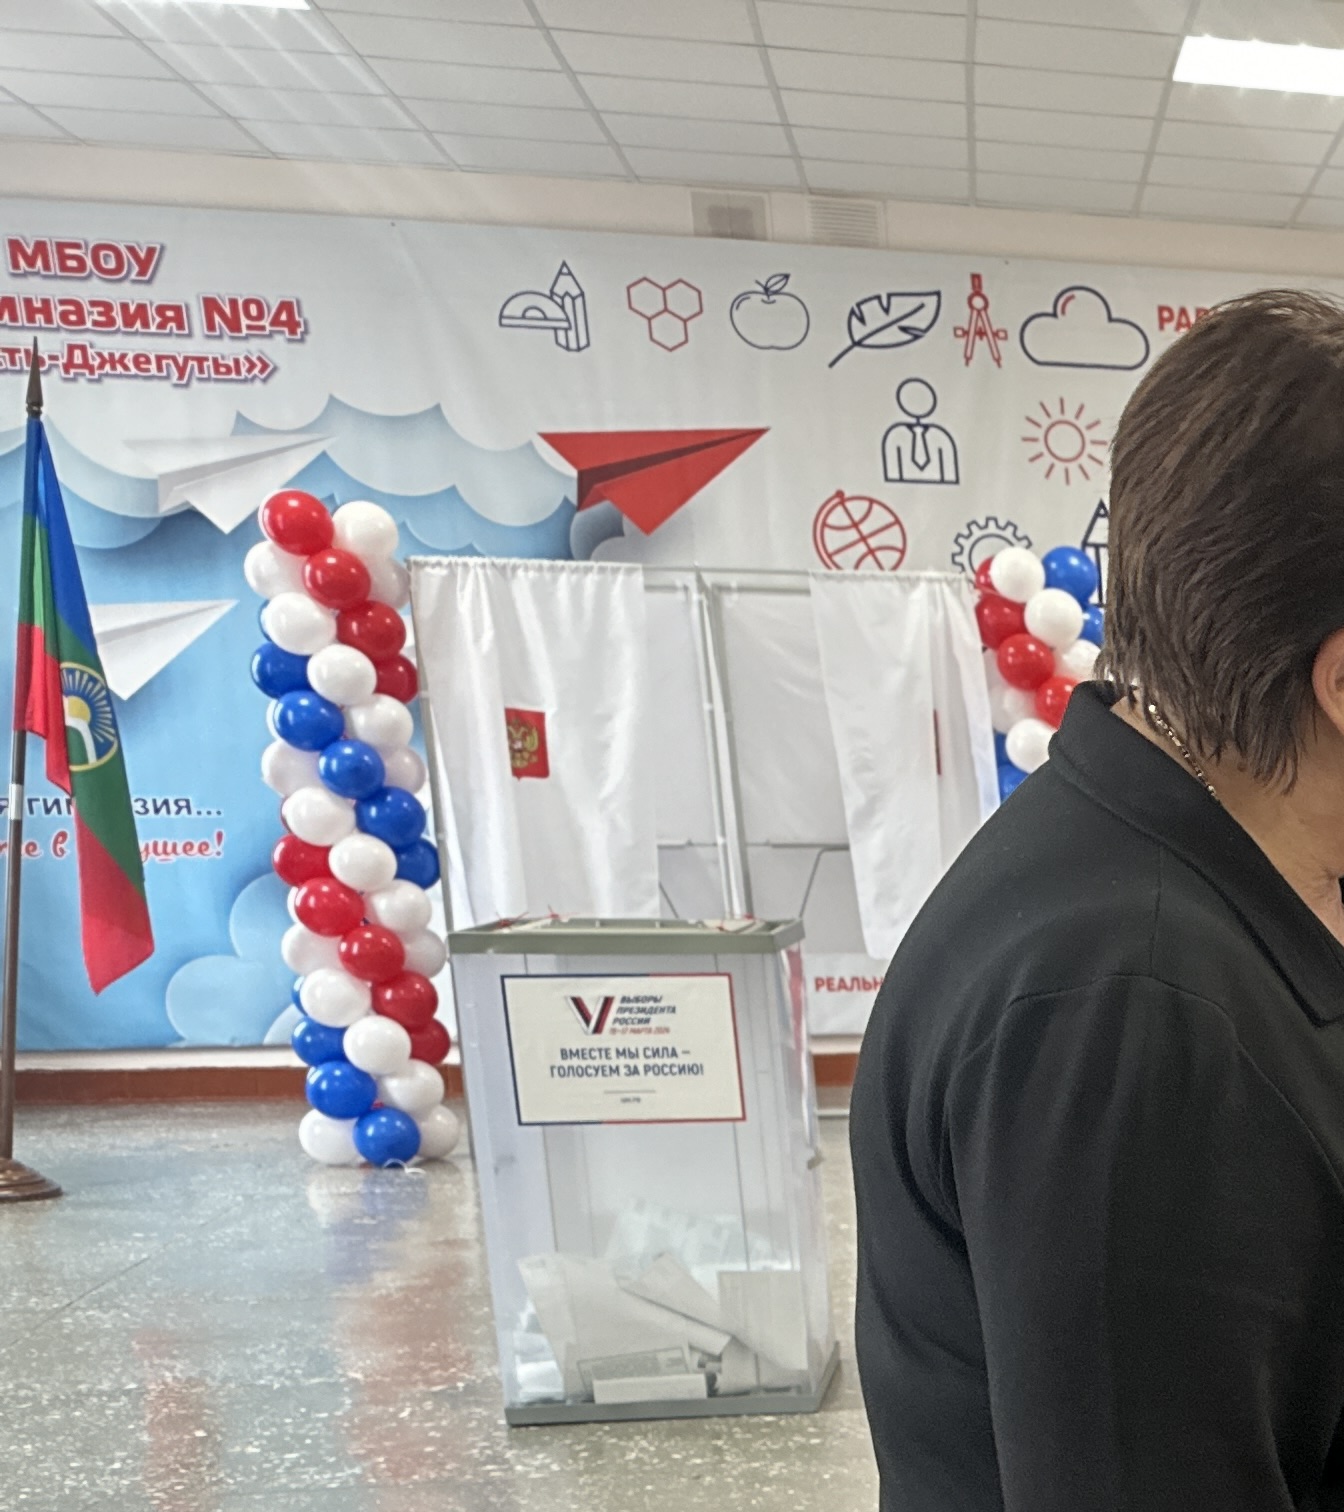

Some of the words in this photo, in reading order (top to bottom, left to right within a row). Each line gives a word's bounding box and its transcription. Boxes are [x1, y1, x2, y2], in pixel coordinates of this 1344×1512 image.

[7, 238, 159, 279] МБОУ
[202, 296, 302, 336] №4
[0, 343, 270, 381] ть-Джегуты»
[814, 975, 884, 992] РЕАЛЬН
[560, 1047, 612, 1061] ВМЕСТЕ
[616, 1047, 639, 1060] МЫ
[643, 1046, 677, 1059] СИЛА
[550, 1063, 620, 1079] ГОЛОСУЕМ
[623, 1063, 640, 1077] ЗА
[644, 1062, 704, 1077] РОССИЮ!
